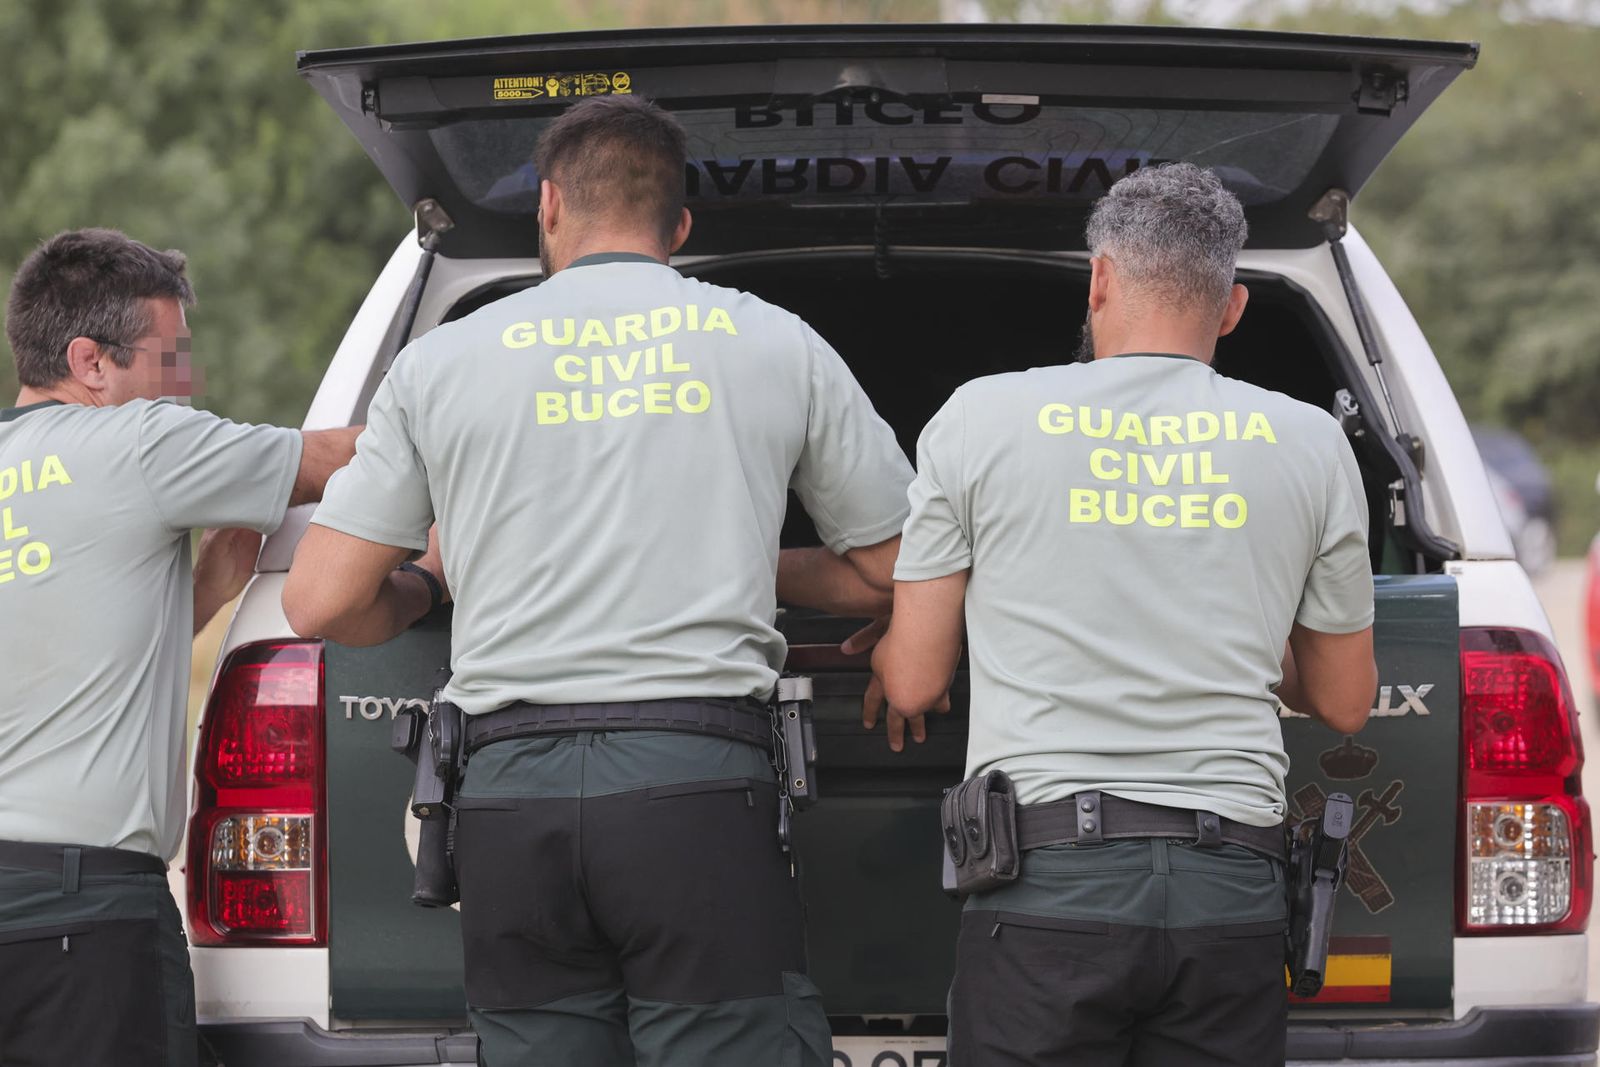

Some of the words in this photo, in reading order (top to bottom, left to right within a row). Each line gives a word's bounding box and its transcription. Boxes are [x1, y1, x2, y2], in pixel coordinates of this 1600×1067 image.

[494, 76, 544, 89] ATTENTION!
[497, 90, 521, 98] 5000
[501, 304, 738, 349] GUARDIA
[553, 343, 691, 385] CIVIL
[535, 380, 711, 425] BUCEO
[1038, 403, 1278, 445] GUARDIA
[1089, 447, 1230, 486] CIVIL
[1069, 488, 1248, 529] BUCEO
